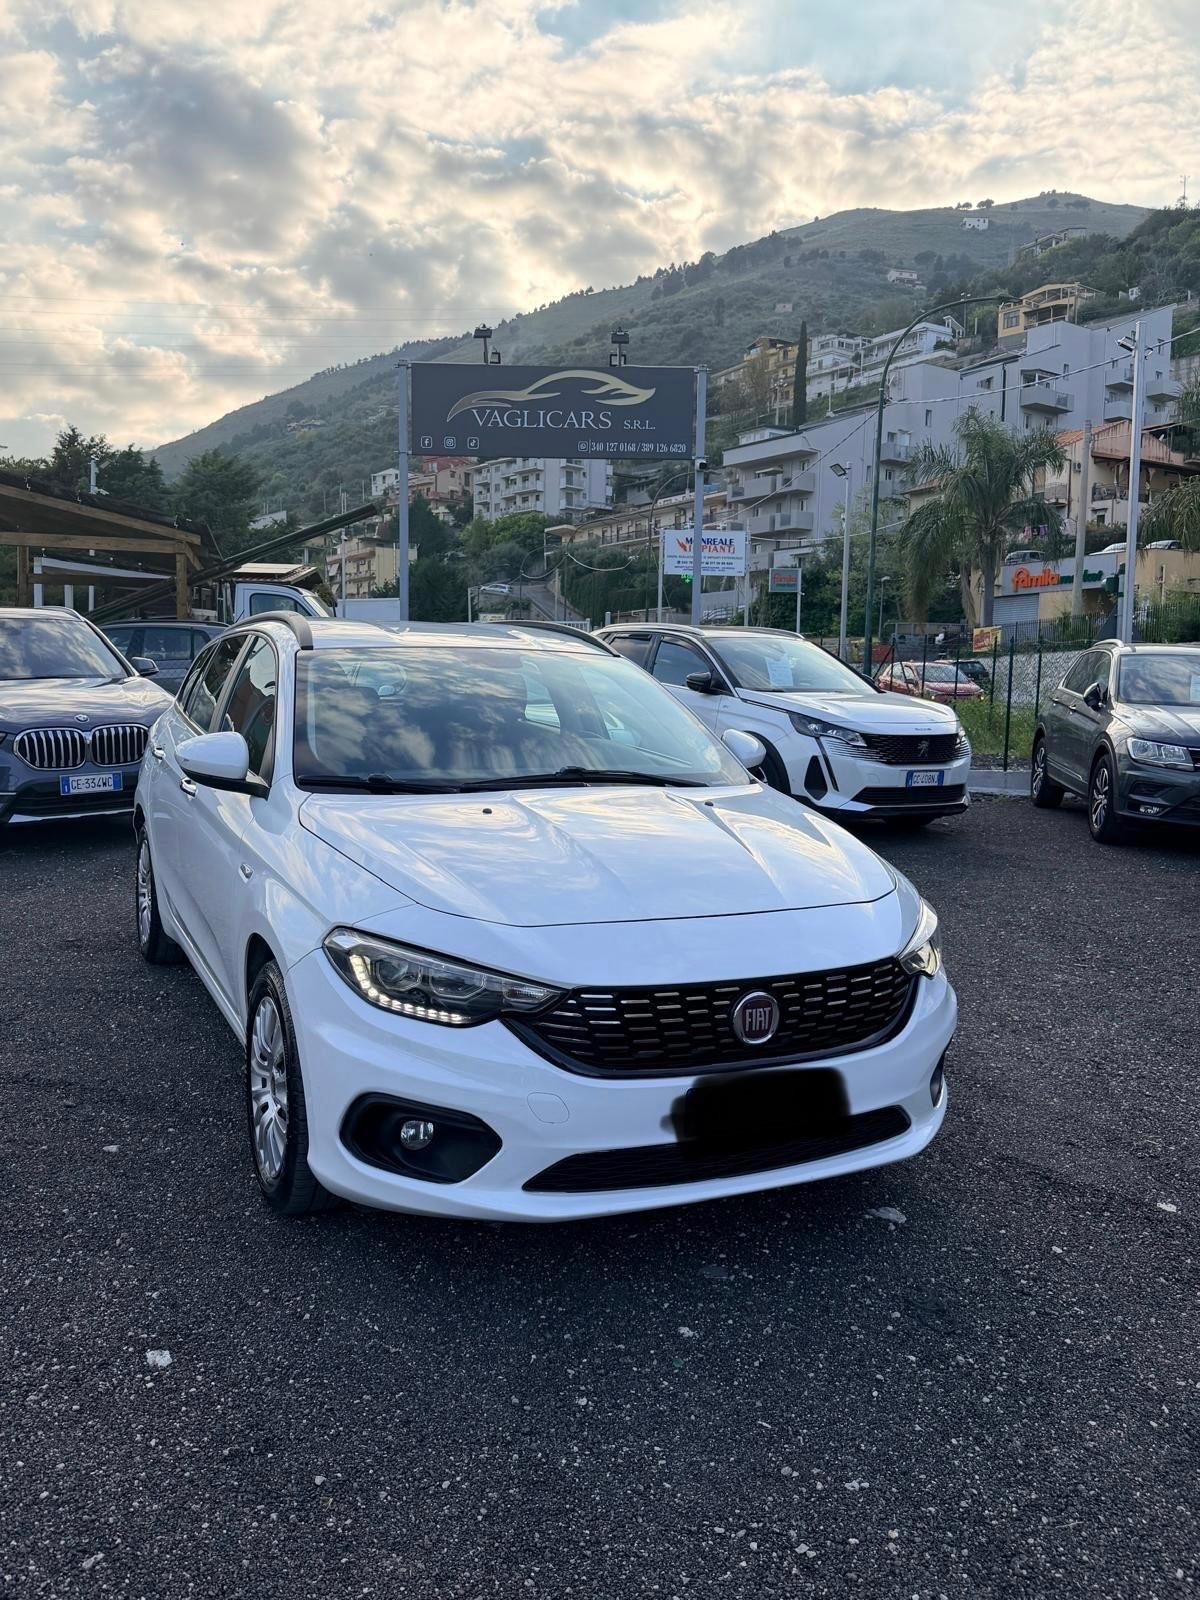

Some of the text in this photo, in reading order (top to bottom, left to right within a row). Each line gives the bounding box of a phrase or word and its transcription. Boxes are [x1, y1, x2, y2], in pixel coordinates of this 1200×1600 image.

[472, 409, 656, 430] VAGLICARS S.R.L.
[591, 442, 604, 452] 340
[606, 442, 618, 452] 127
[656, 443, 668, 453] 126
[669, 443, 686, 453] 6820
[685, 537, 735, 546] MNREALE
[688, 545, 736, 554] IPIANTI
[745, 1007, 772, 1032] FIAT
